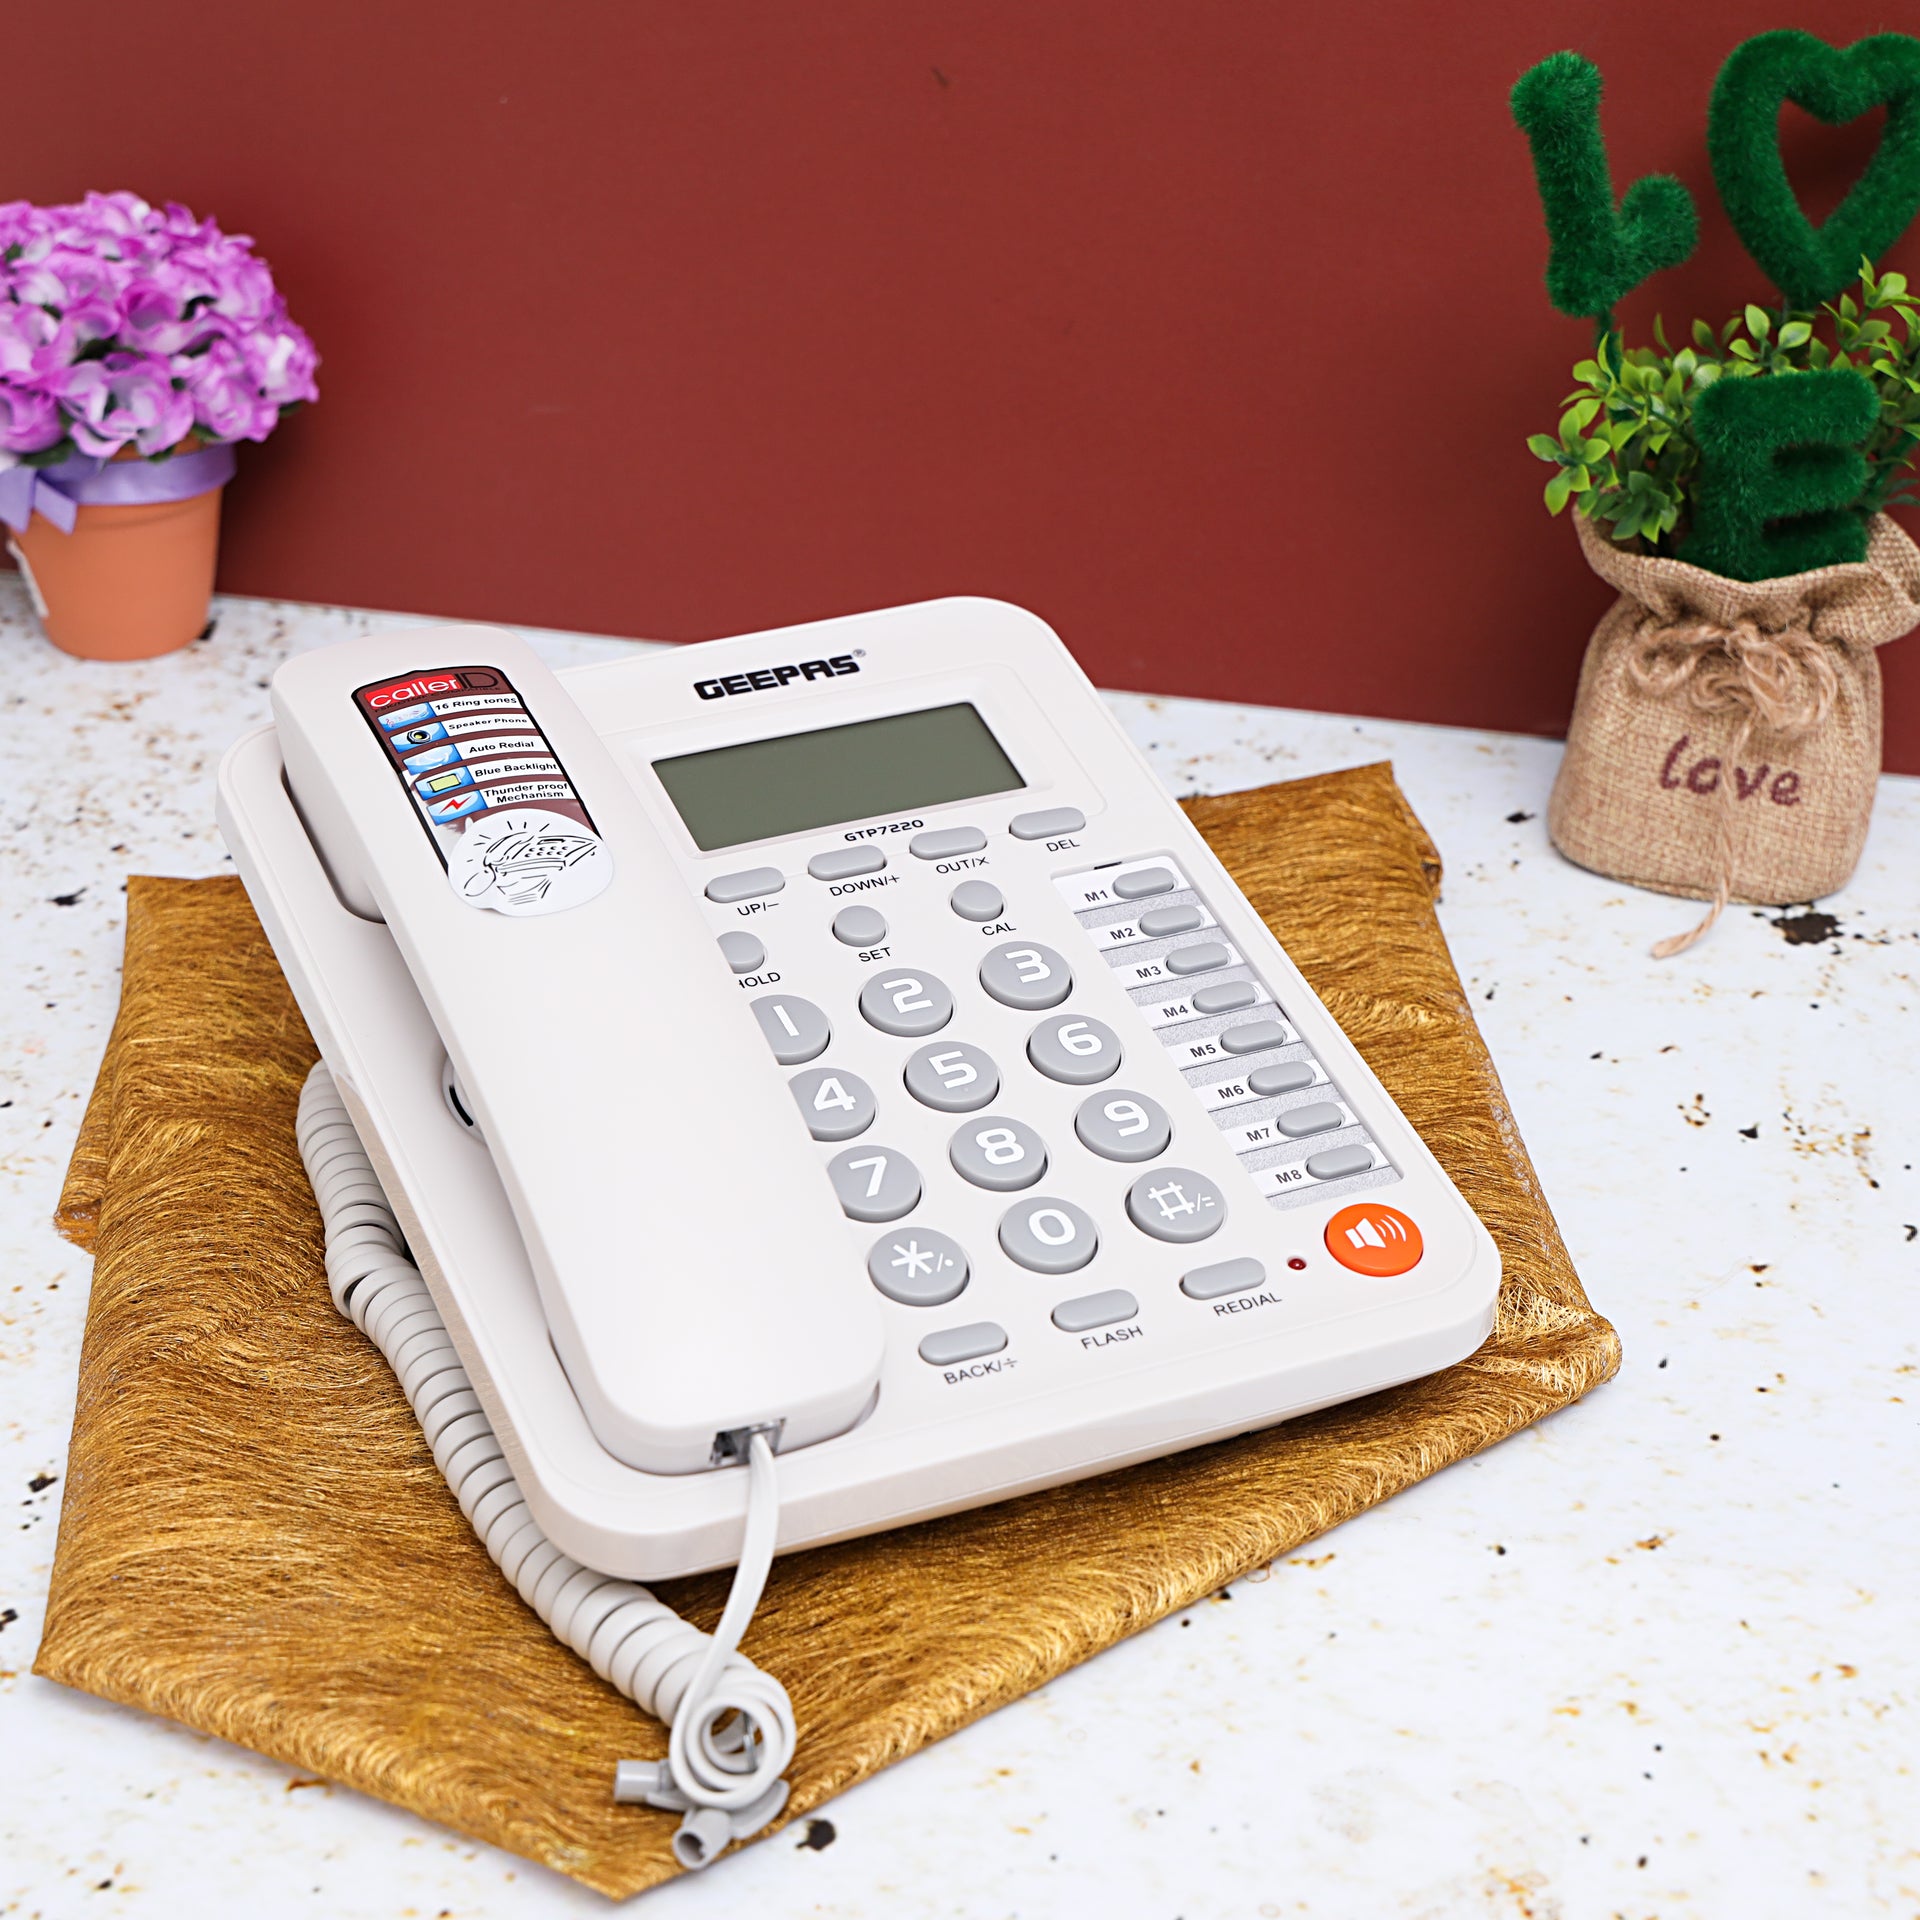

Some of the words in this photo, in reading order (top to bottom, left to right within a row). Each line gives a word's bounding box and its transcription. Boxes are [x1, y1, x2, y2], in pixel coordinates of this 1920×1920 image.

[448, 719, 492, 730] Speaker
[469, 743, 496, 753] Auto
[499, 741, 534, 749] Redial
[474, 767, 501, 777] Blue
[504, 763, 558, 771] Backlight
[484, 784, 534, 798] Thunder
[496, 792, 564, 804] Mechanism
[844, 819, 924, 842] GTP7220
[1046, 838, 1080, 852] DEL
[830, 875, 899, 897] DOWN/+
[1084, 889, 1109, 902] M1
[982, 921, 1017, 937] CAL
[1110, 927, 1136, 940] M2
[858, 946, 892, 963] SET
[1005, 949, 1051, 984] 3
[1136, 965, 1162, 979] M3
[882, 977, 934, 1014] 2
[1162, 1006, 1189, 1018] M4
[772, 1004, 799, 1037] 1
[1057, 1021, 1103, 1057] 6
[1189, 1044, 1217, 1058] M5
[928, 1050, 979, 1090] 5
[813, 1077, 857, 1112] 4
[1217, 1084, 1245, 1100] M6
[1102, 1099, 1151, 1137] 9
[1246, 1127, 1271, 1142] M7
[975, 1127, 1026, 1166] 8
[848, 1155, 888, 1199] 7
[1275, 1169, 1303, 1184] M8
[1028, 1208, 1077, 1247] 0
[1212, 1290, 1283, 1318] REDIAL
[1080, 1324, 1145, 1351] FLASH
